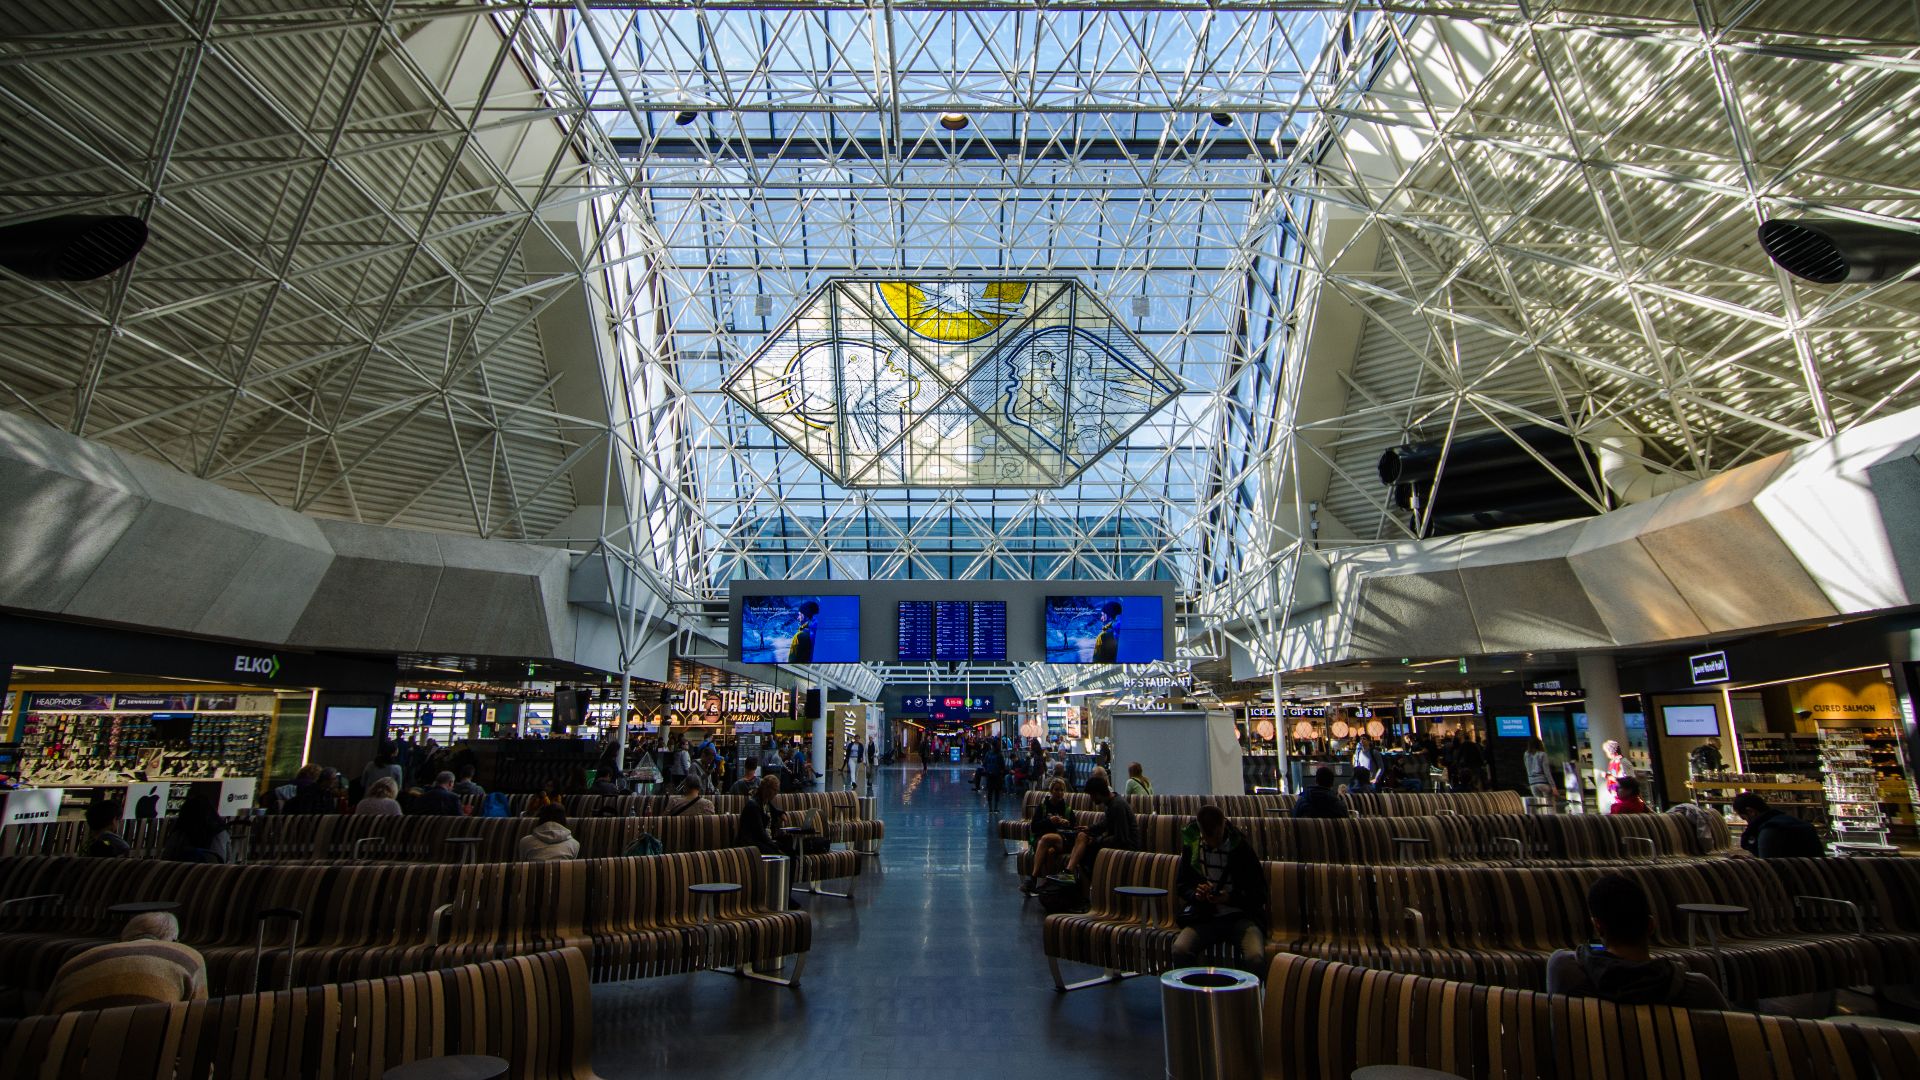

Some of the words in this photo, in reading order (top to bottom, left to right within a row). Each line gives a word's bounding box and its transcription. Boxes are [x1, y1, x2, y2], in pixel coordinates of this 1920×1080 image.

[235, 655, 272, 674] ELKO
[36, 698, 82, 706] HEADPHONES
[680, 689, 708, 712] JOE
[720, 690, 747, 713] THE
[751, 690, 790, 713] JUICE
[1291, 707, 1312, 716] GIFT
[1813, 704, 1841, 713] CURED
[1842, 704, 1876, 713] SALMON
[14, 811, 49, 820] SAMSUNG
